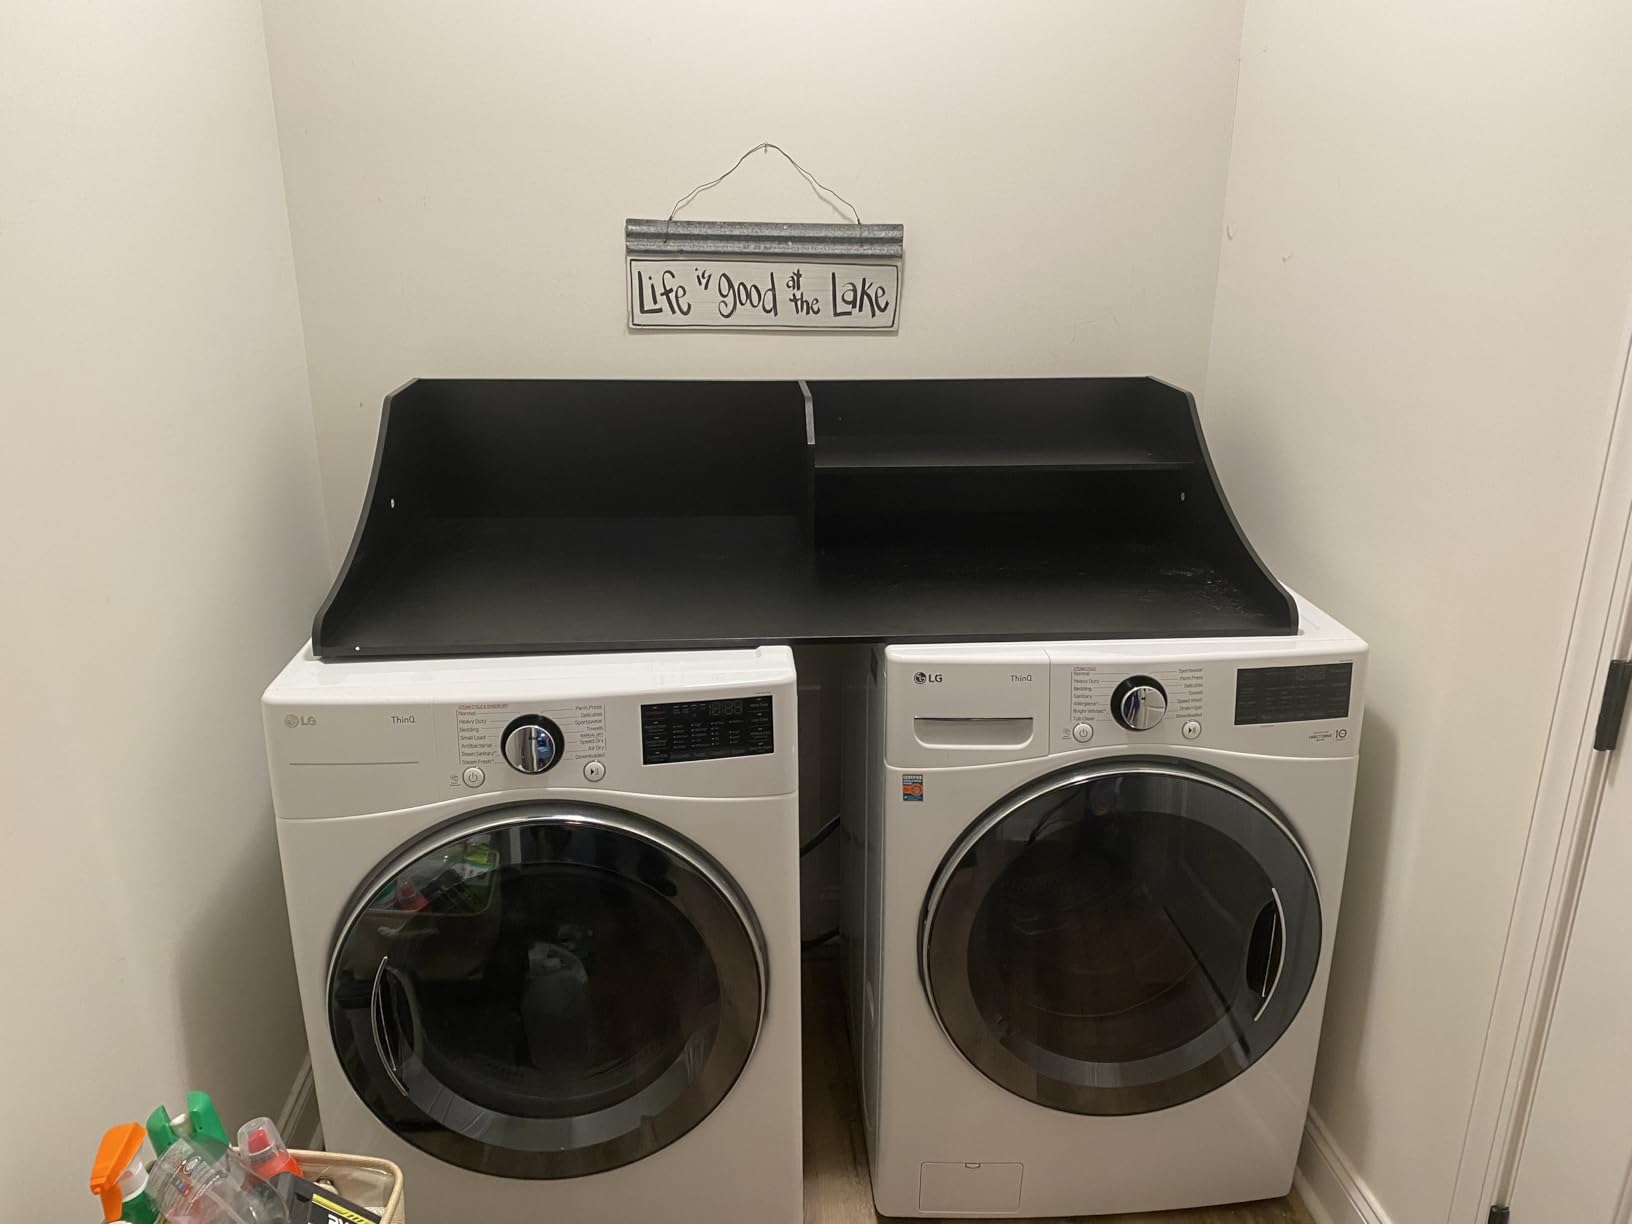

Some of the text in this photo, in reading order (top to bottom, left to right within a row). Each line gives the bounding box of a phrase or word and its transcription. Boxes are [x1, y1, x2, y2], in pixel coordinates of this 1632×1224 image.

[637, 267, 803, 319] Life is good at
[788, 271, 890, 319] the Lake
[1010, 675, 1033, 683] ThinQ
[391, 715, 416, 724] ThinQ
